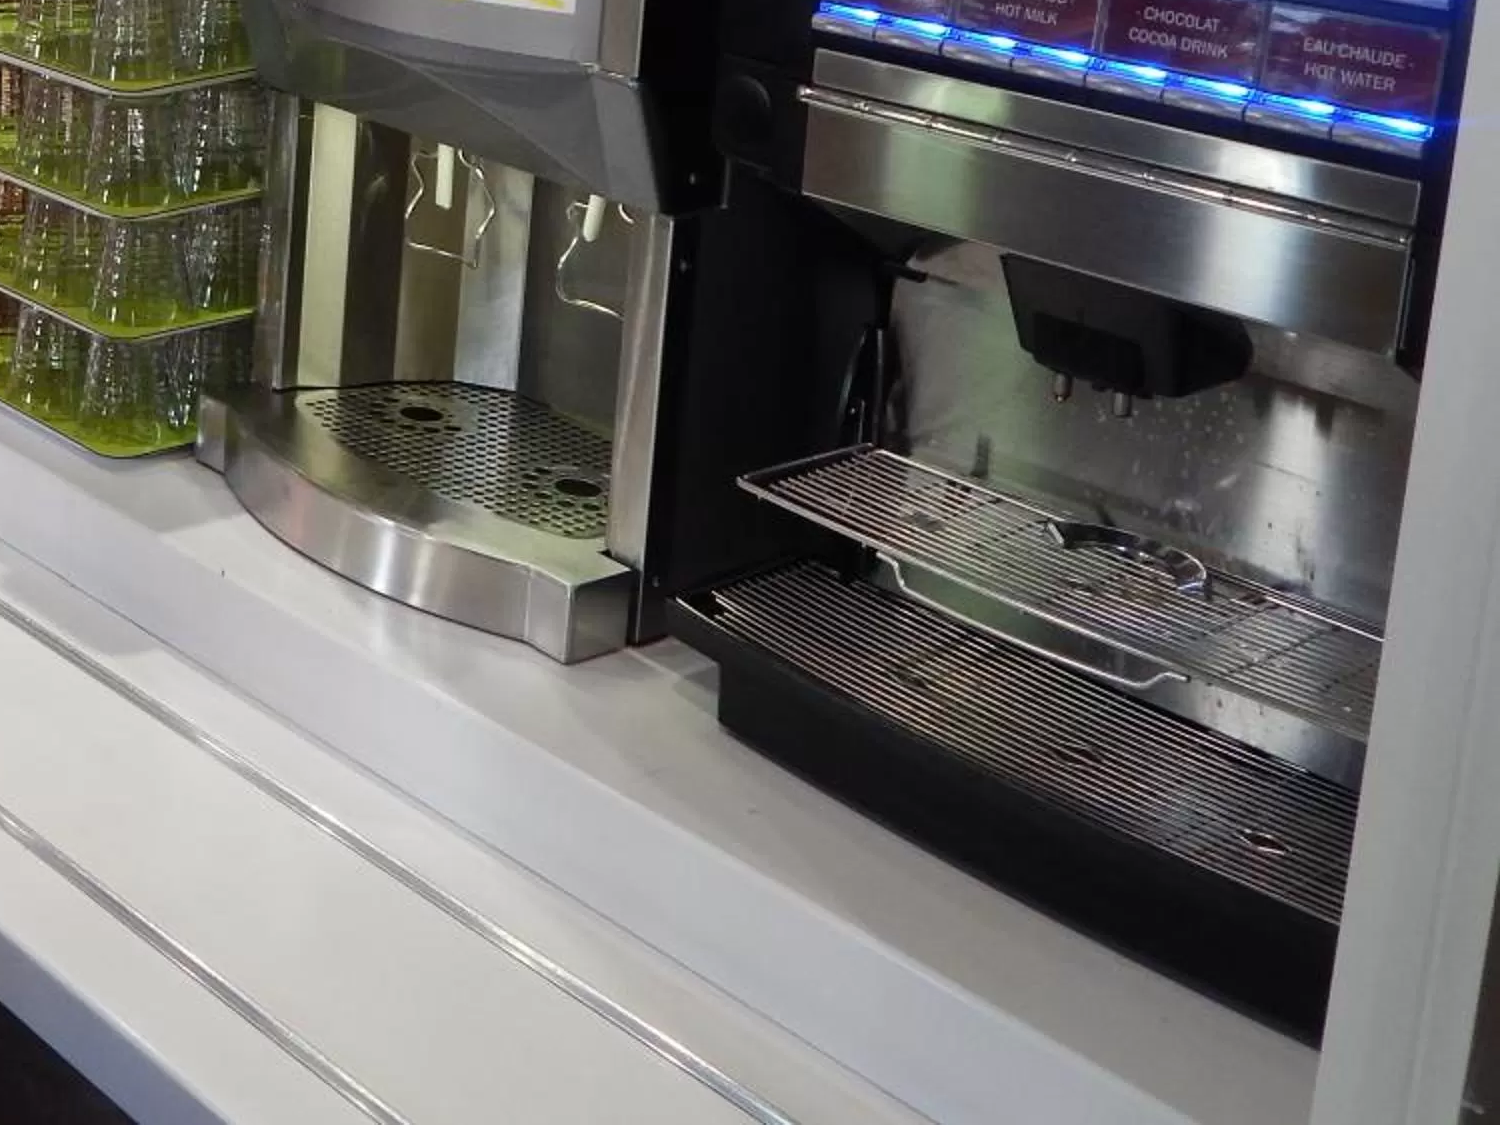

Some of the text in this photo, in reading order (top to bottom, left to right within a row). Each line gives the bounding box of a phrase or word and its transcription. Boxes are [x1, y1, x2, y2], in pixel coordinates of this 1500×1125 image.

[995, 3, 1058, 26] HOT MILK
[1143, 6, 1221, 32] CHOCOLAT
[1128, 27, 1229, 59] COCOA DRINK
[1303, 36, 1406, 68] EAU CHAUDE
[1304, 62, 1396, 92] HOT WATER
